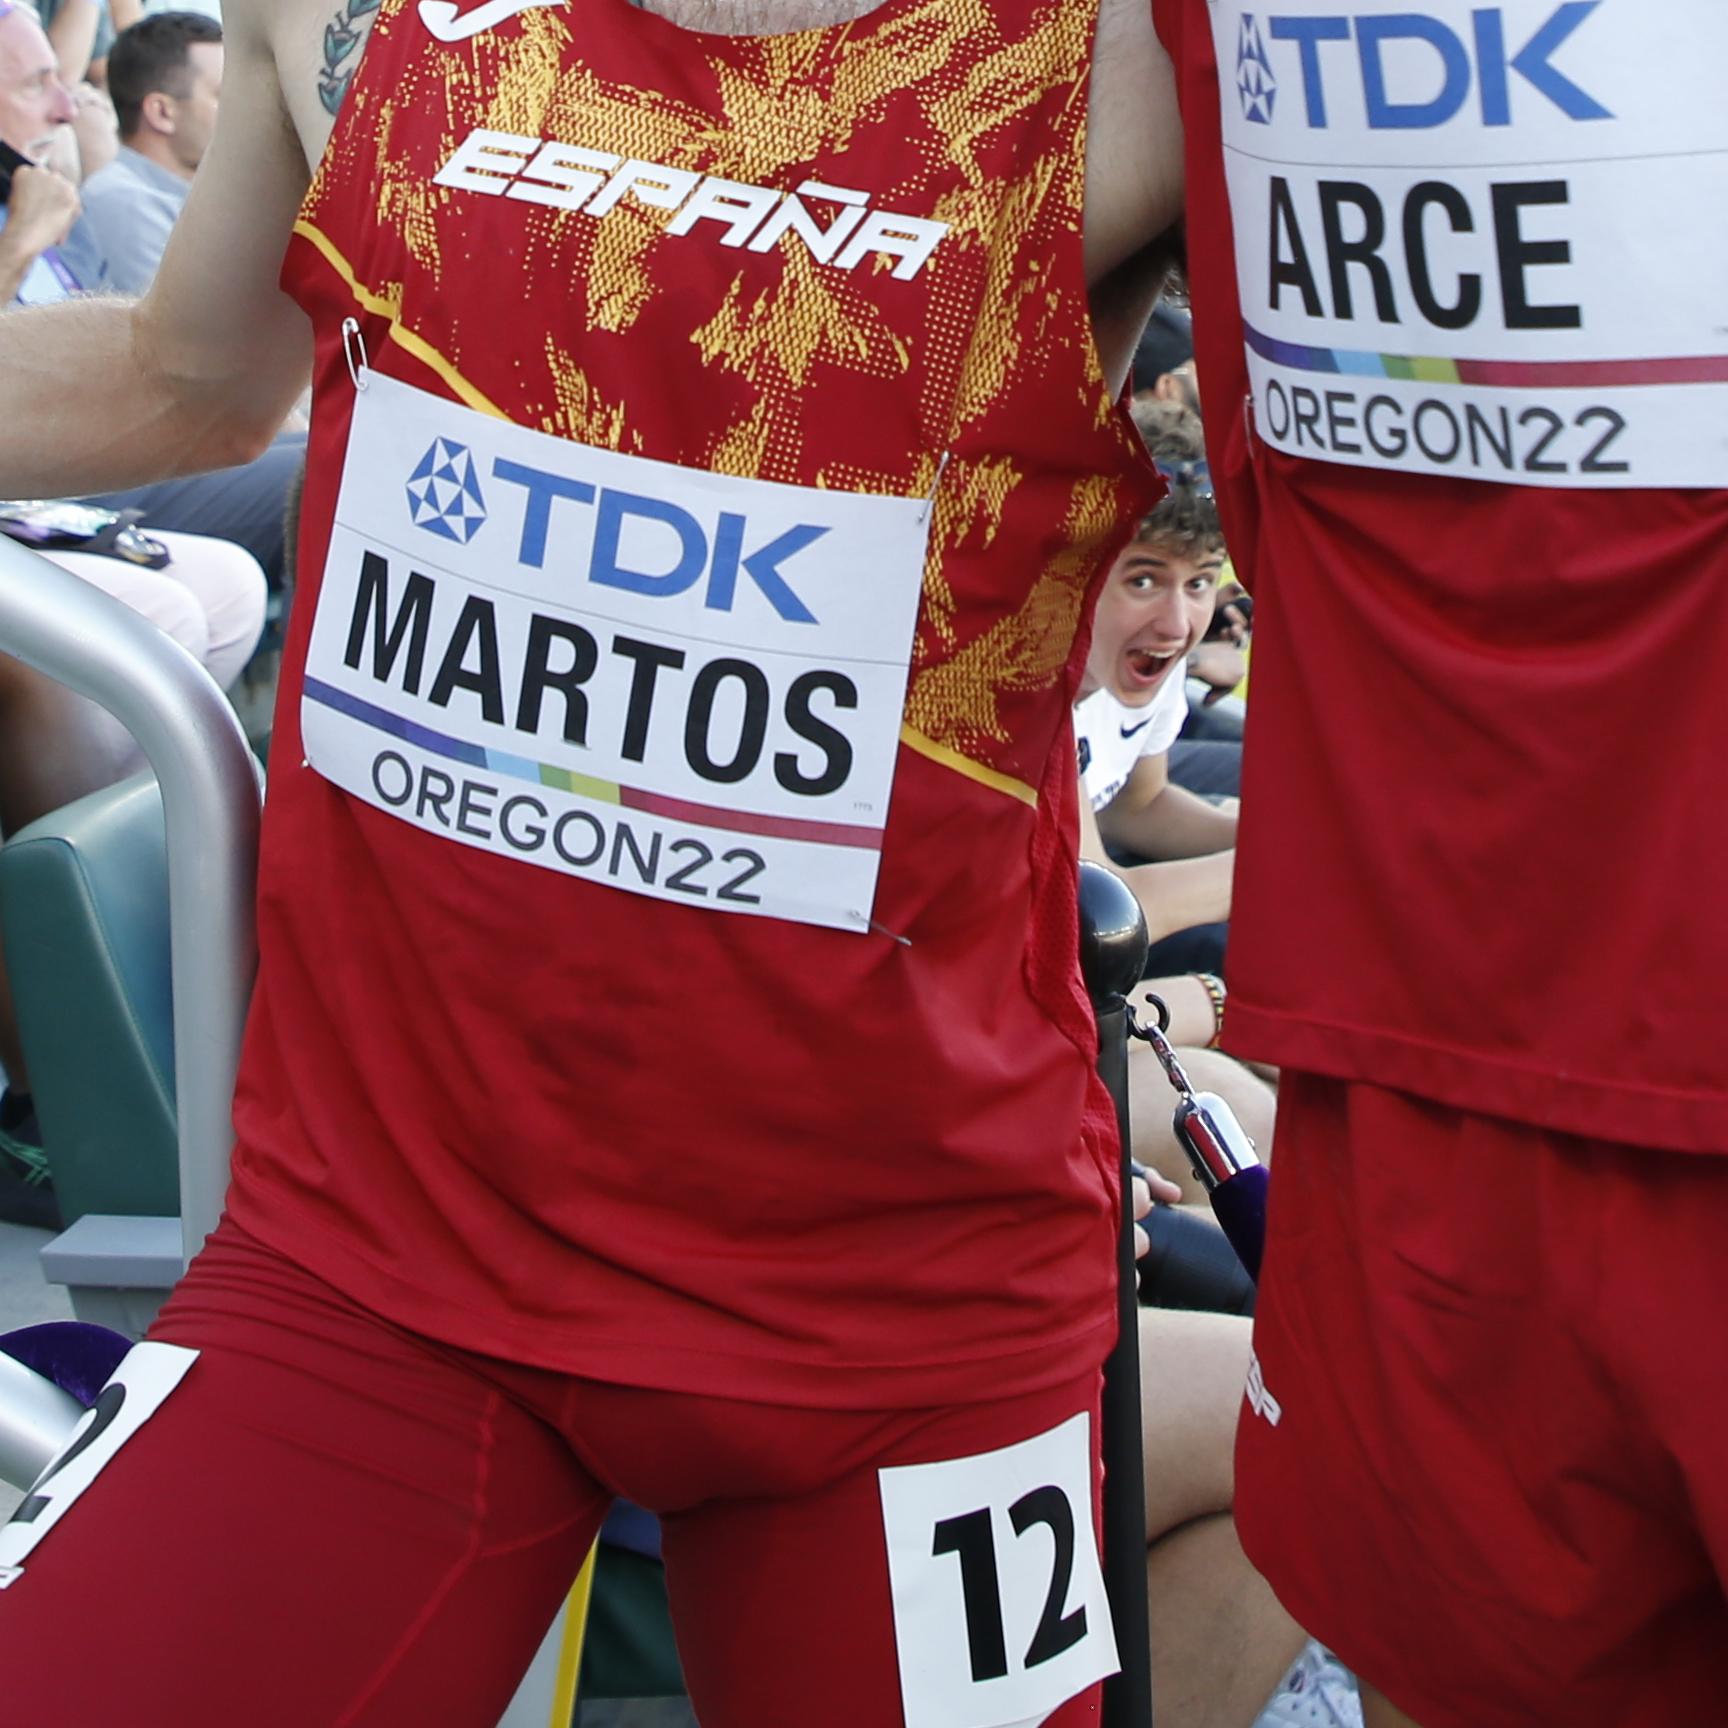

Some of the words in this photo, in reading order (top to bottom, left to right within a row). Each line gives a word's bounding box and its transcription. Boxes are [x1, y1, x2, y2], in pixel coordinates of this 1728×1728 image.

[432, 126, 951, 282] ESPAÑA
[1267, 175, 1583, 331] ARCE
[1265, 378, 1630, 474] OREGON22
[491, 455, 832, 626] TDK
[343, 550, 860, 798] MARTOS
[370, 749, 767, 906] OREGON22
[930, 1483, 1089, 1684] 12
